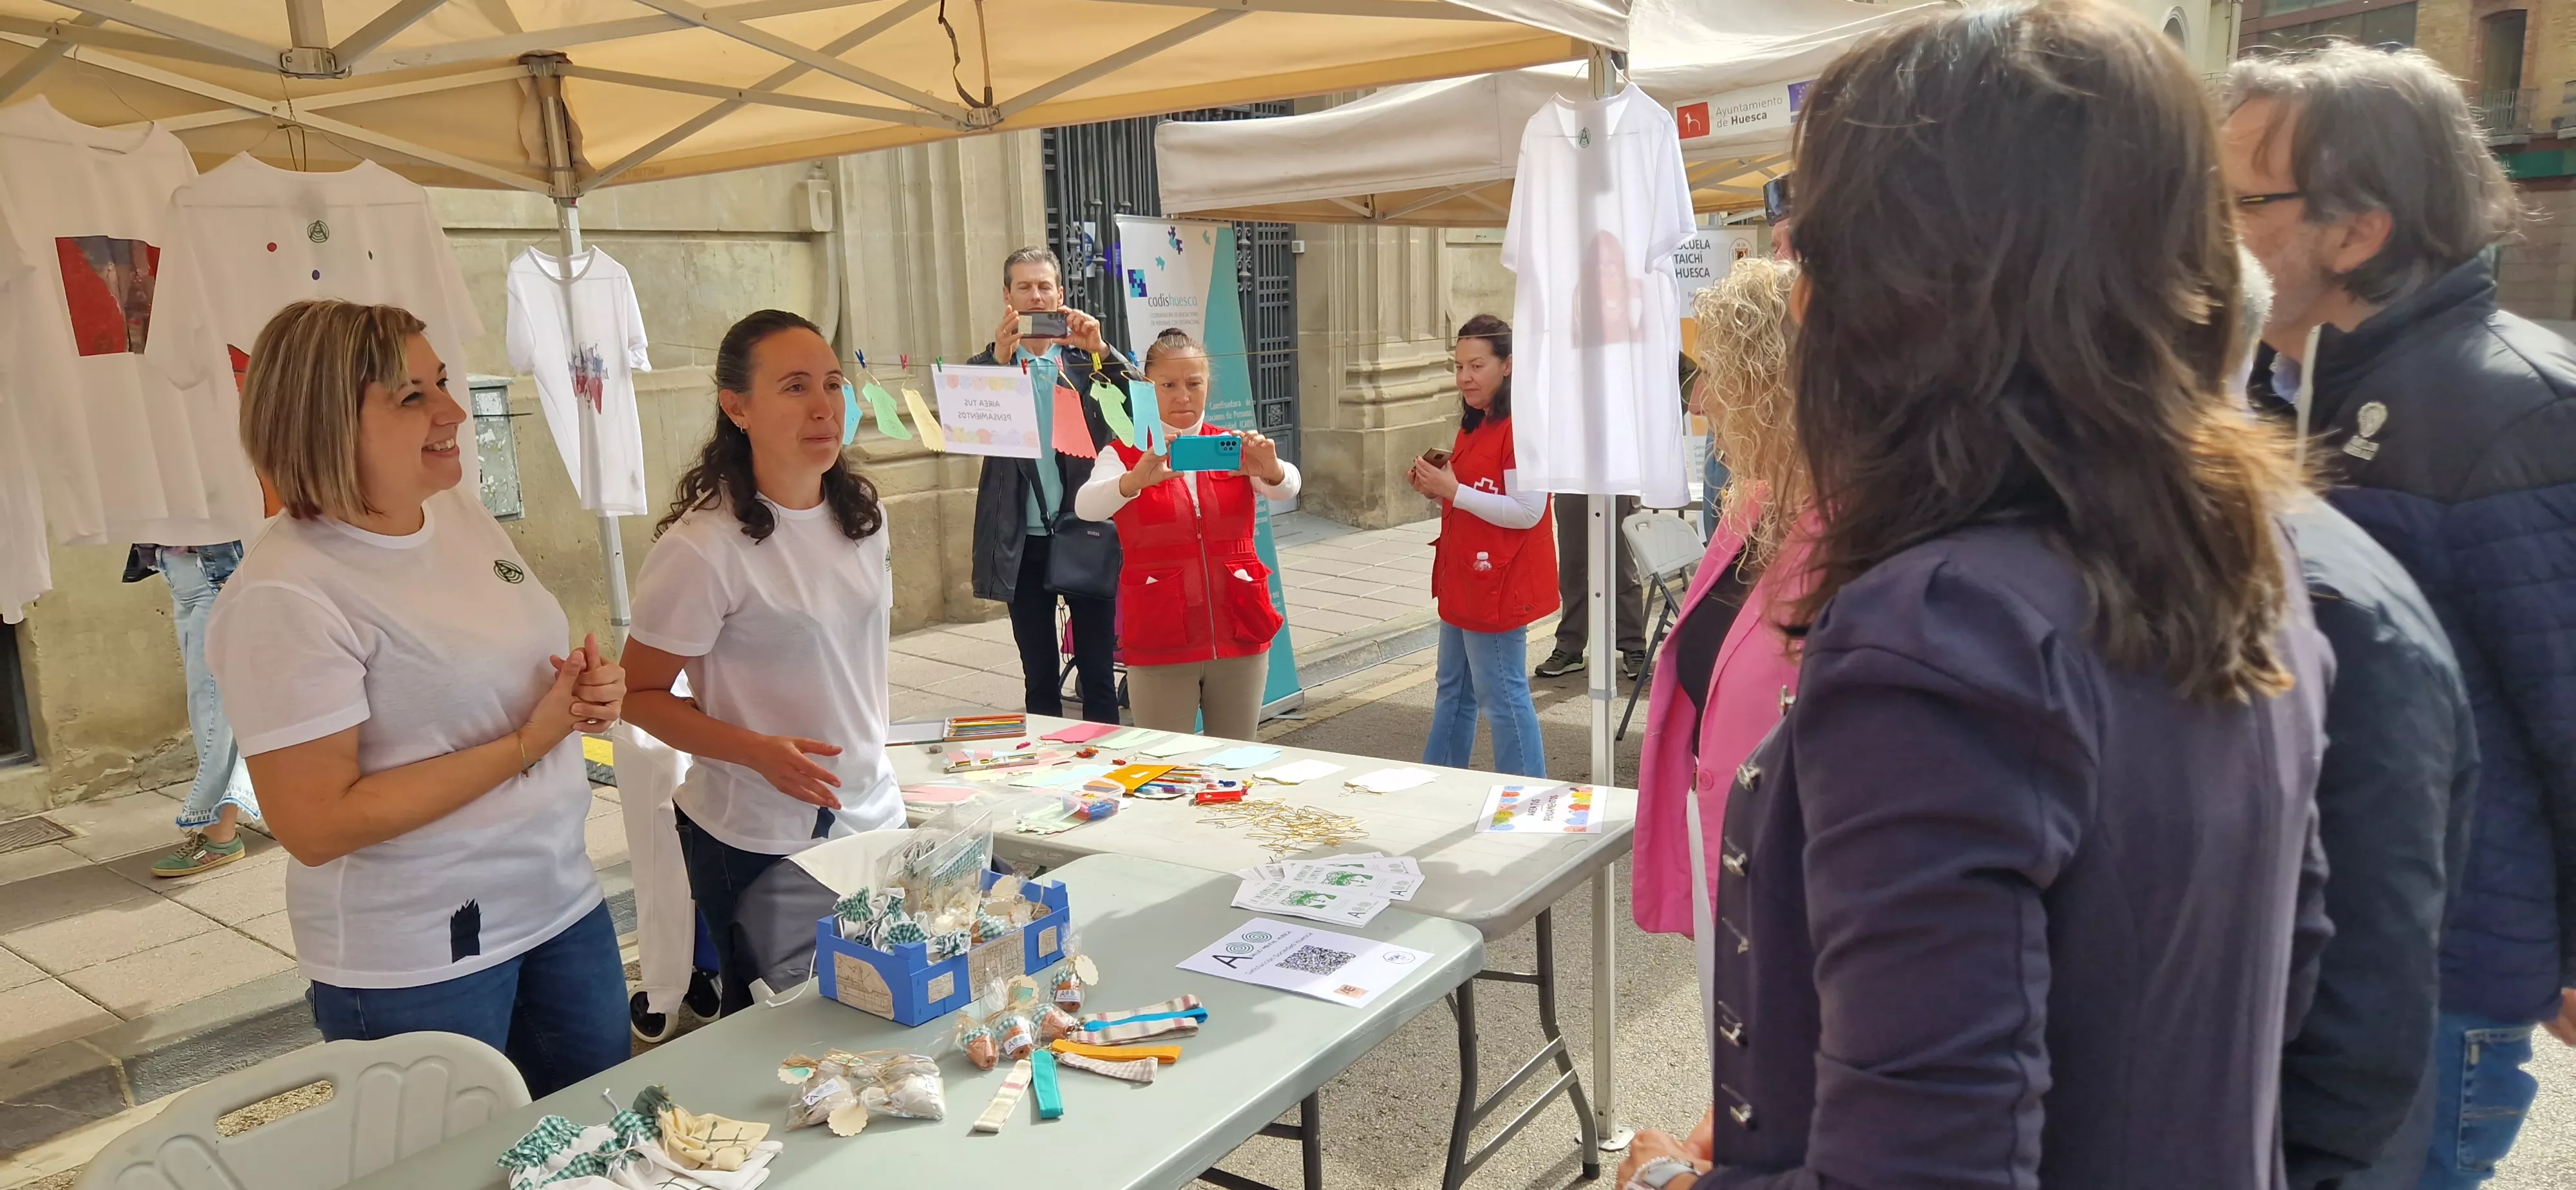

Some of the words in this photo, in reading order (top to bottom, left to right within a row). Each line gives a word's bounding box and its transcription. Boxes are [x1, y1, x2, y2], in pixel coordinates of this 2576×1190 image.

[1716, 97, 1783, 117] Ayuntamiento
[1717, 118, 1728, 128] de
[1731, 111, 1767, 126] Huesca
[1674, 251, 1703, 265] TAICHÍ
[1675, 267, 1710, 278] HUESCA
[1148, 293, 1197, 307] cadishuesca
